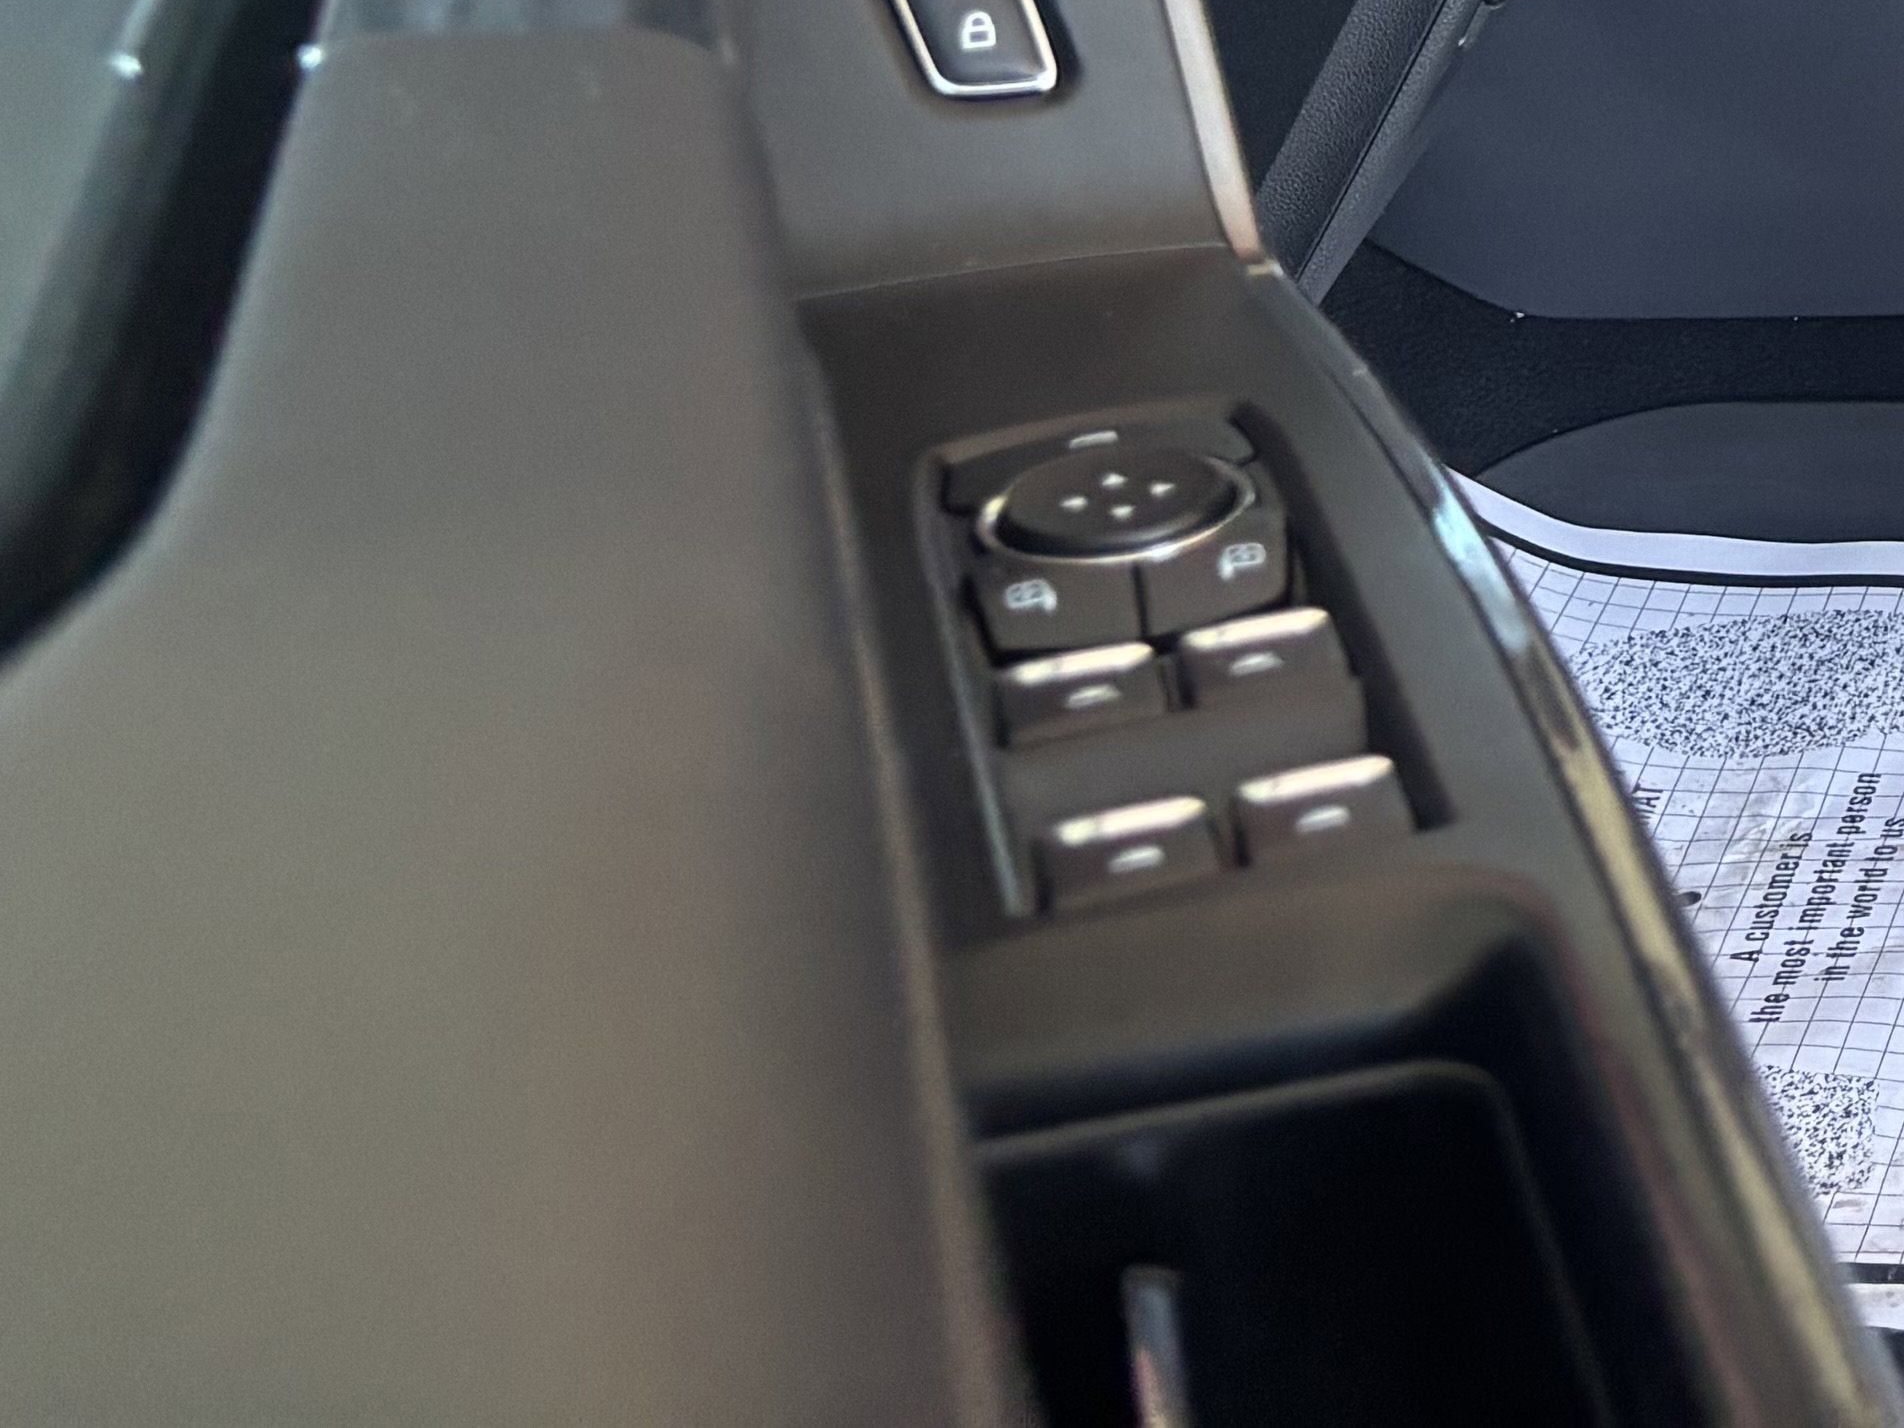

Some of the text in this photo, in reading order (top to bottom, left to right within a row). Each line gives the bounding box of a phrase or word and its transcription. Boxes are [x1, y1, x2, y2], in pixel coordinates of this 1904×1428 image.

[1866, 844, 1898, 862] to
[1730, 831, 1813, 963] A customer is
[1749, 772, 1882, 1023] the most important person
[1846, 868, 1888, 920] world
[1825, 926, 1865, 959] the
[1814, 965, 1850, 982] in
